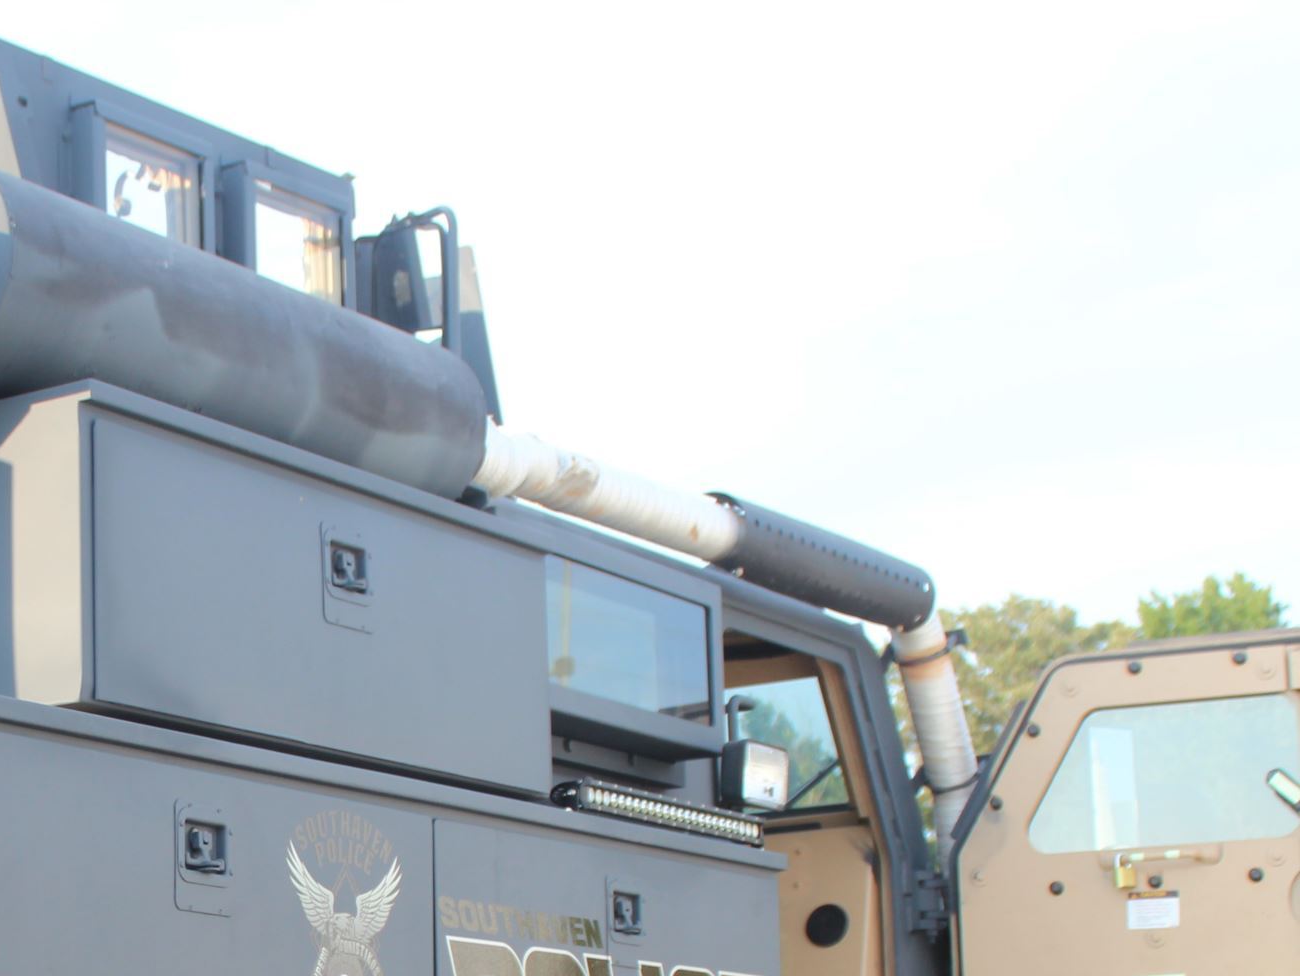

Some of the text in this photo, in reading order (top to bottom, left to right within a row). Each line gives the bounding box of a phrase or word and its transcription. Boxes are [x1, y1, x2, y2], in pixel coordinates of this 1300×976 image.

[295, 810, 396, 865] SOUTHAVEN
[315, 837, 376, 876] POLICE
[438, 895, 604, 950] SOUTHAVEN
